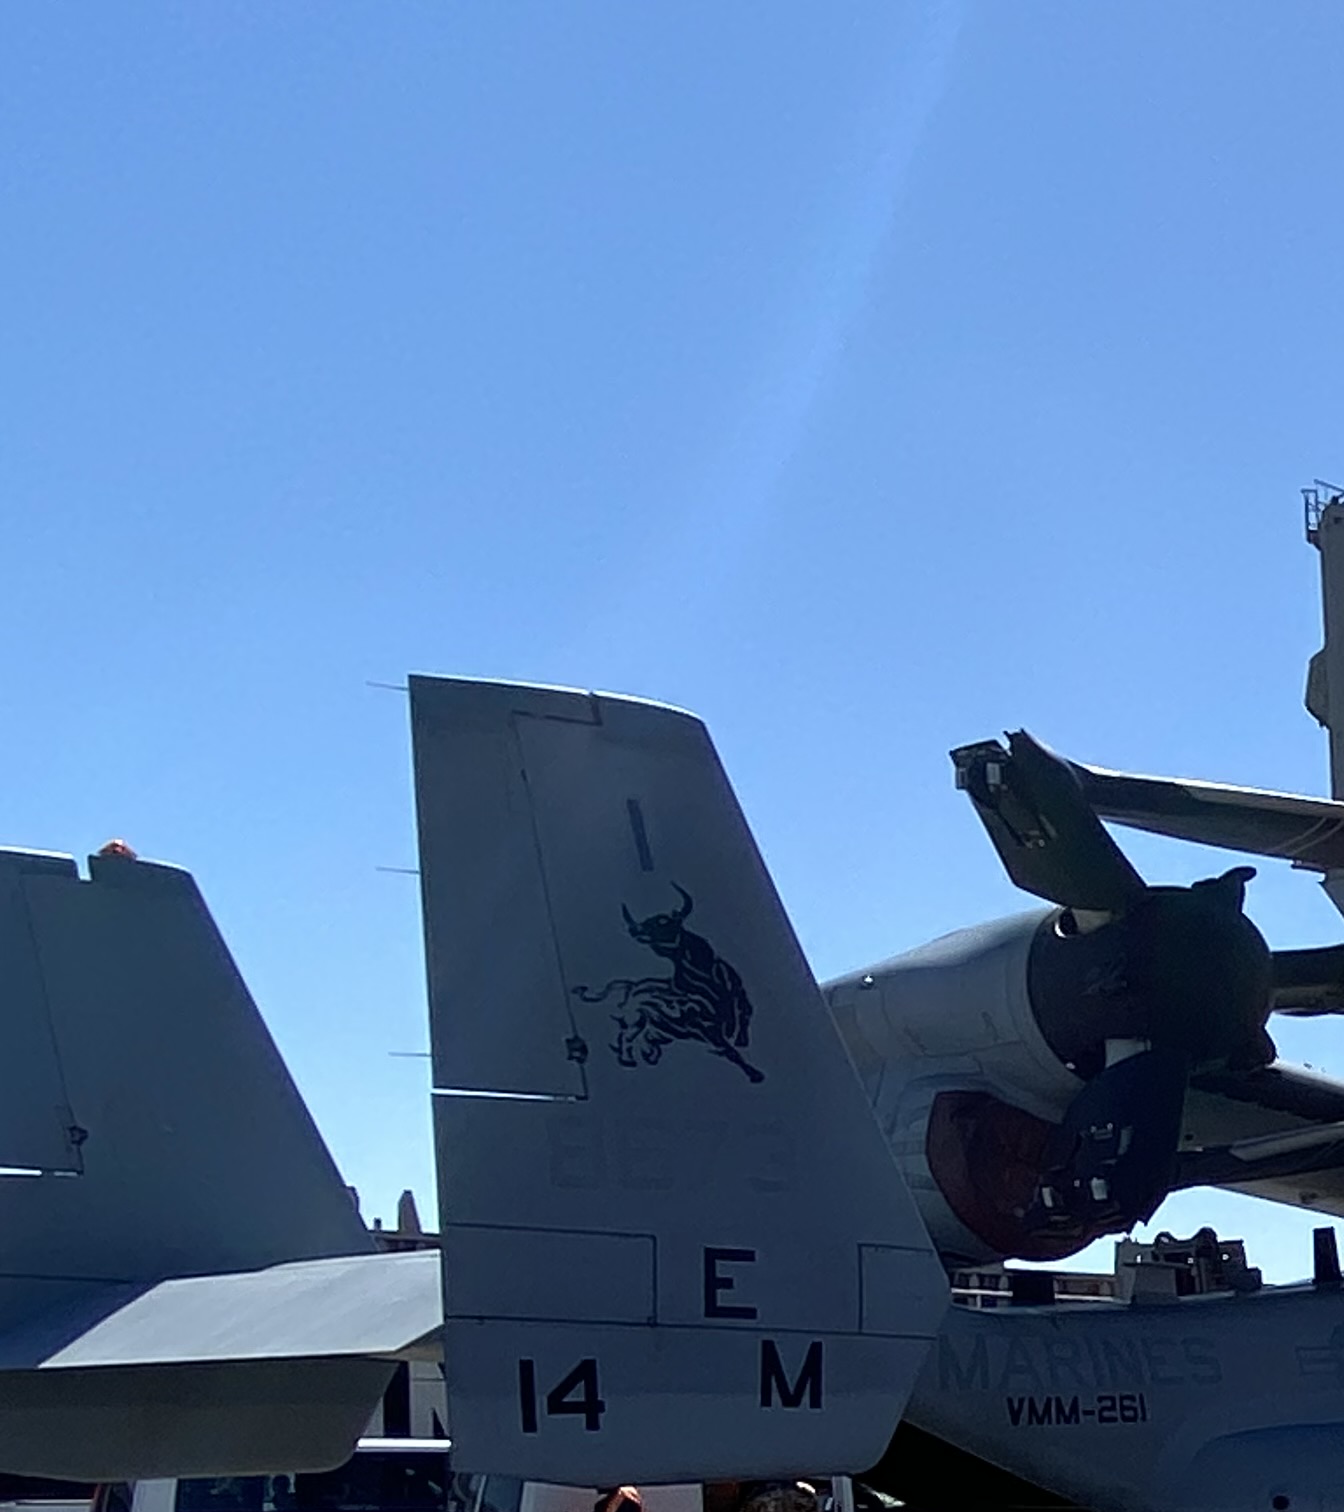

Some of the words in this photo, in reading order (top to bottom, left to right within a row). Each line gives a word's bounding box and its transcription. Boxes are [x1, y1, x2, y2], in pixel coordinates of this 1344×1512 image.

[704, 1247, 757, 1320] E
[519, 1359, 605, 1433] 14
[760, 1339, 823, 1409] M
[938, 1332, 1223, 1390] MARINES
[1006, 1392, 1147, 1427] VMM-261
